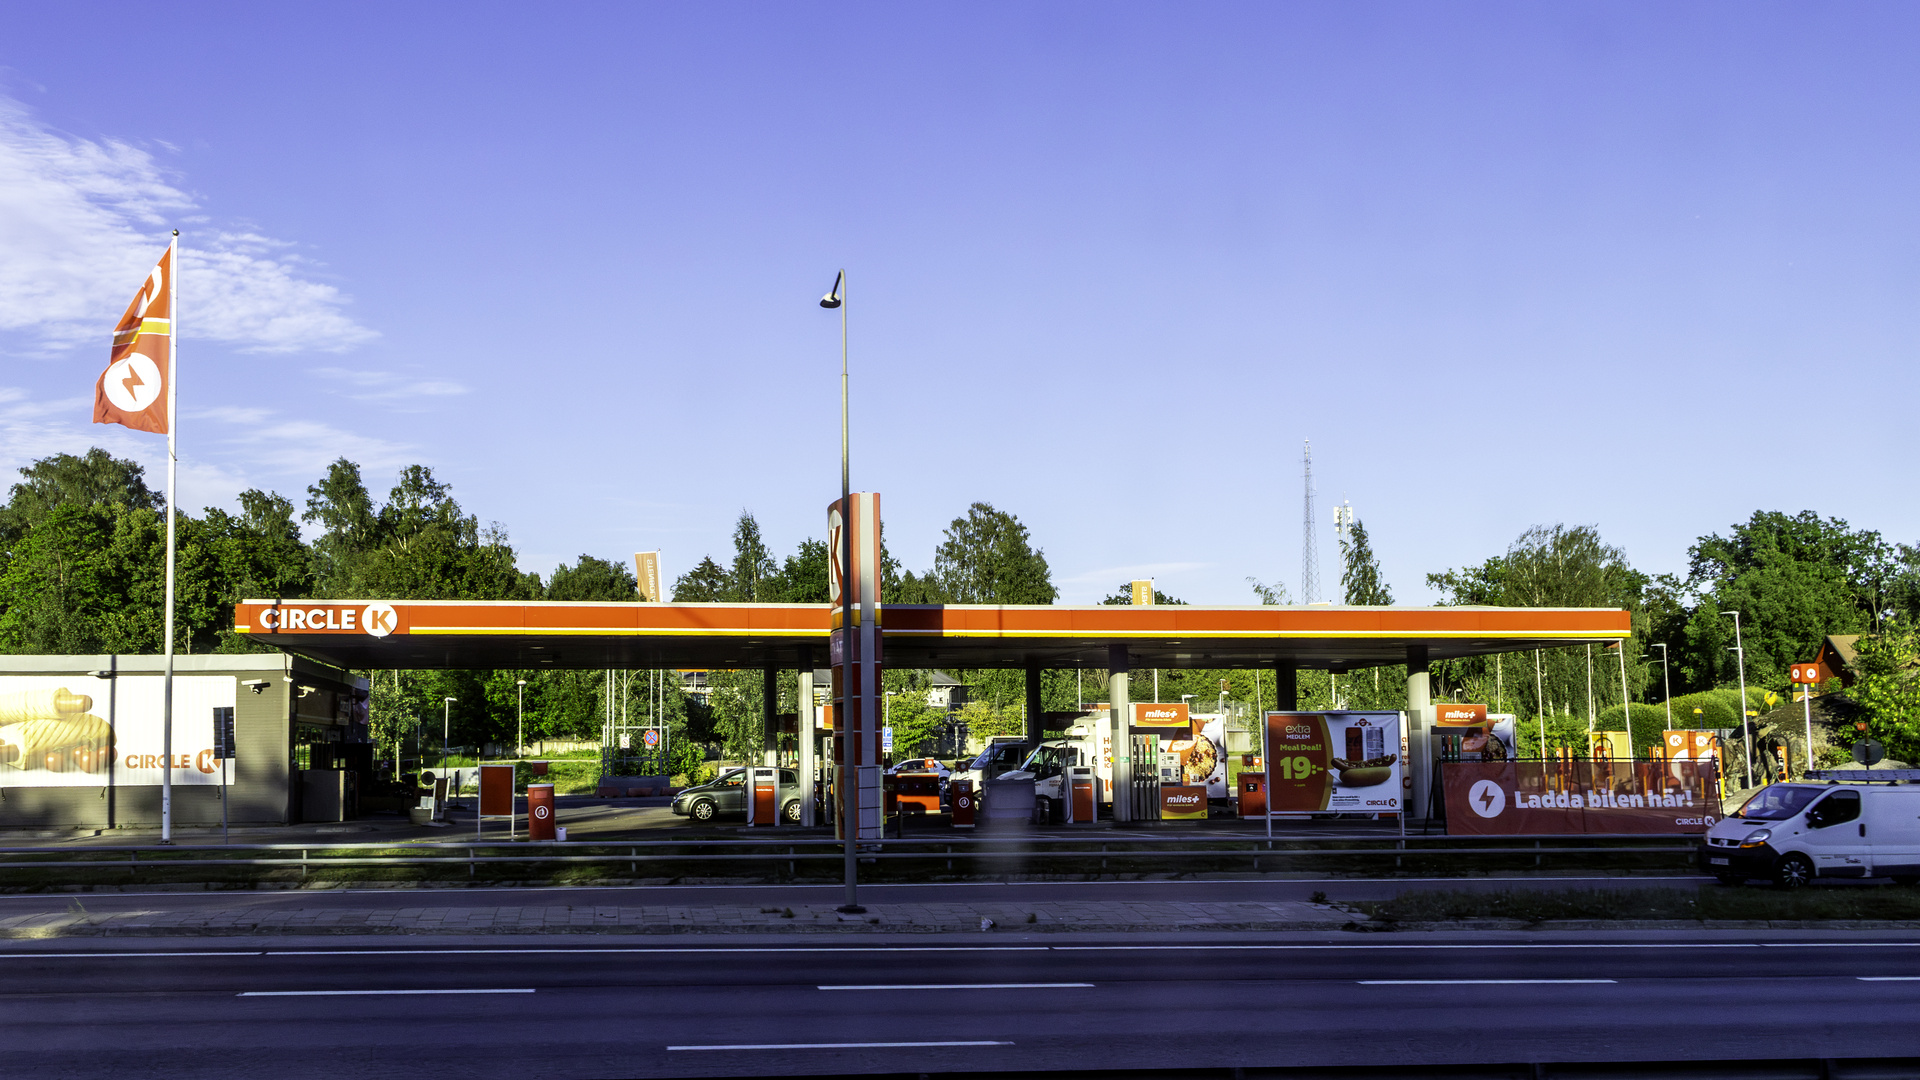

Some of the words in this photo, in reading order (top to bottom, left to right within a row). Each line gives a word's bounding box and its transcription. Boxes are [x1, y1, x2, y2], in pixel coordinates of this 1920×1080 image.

[259, 608, 356, 630] CIRCLE
[1145, 709, 1178, 718] miles+
[1445, 710, 1476, 719] miles+
[1285, 724, 1311, 734] extra
[124, 754, 191, 769] CIRCLE
[1279, 756, 1324, 780] 19:-
[1167, 794, 1200, 804] miles+
[1515, 790, 1584, 809] Ladda
[1588, 789, 1644, 808] bilen
[1647, 789, 1694, 808] här!
[1675, 817, 1703, 826] CIRCLE
